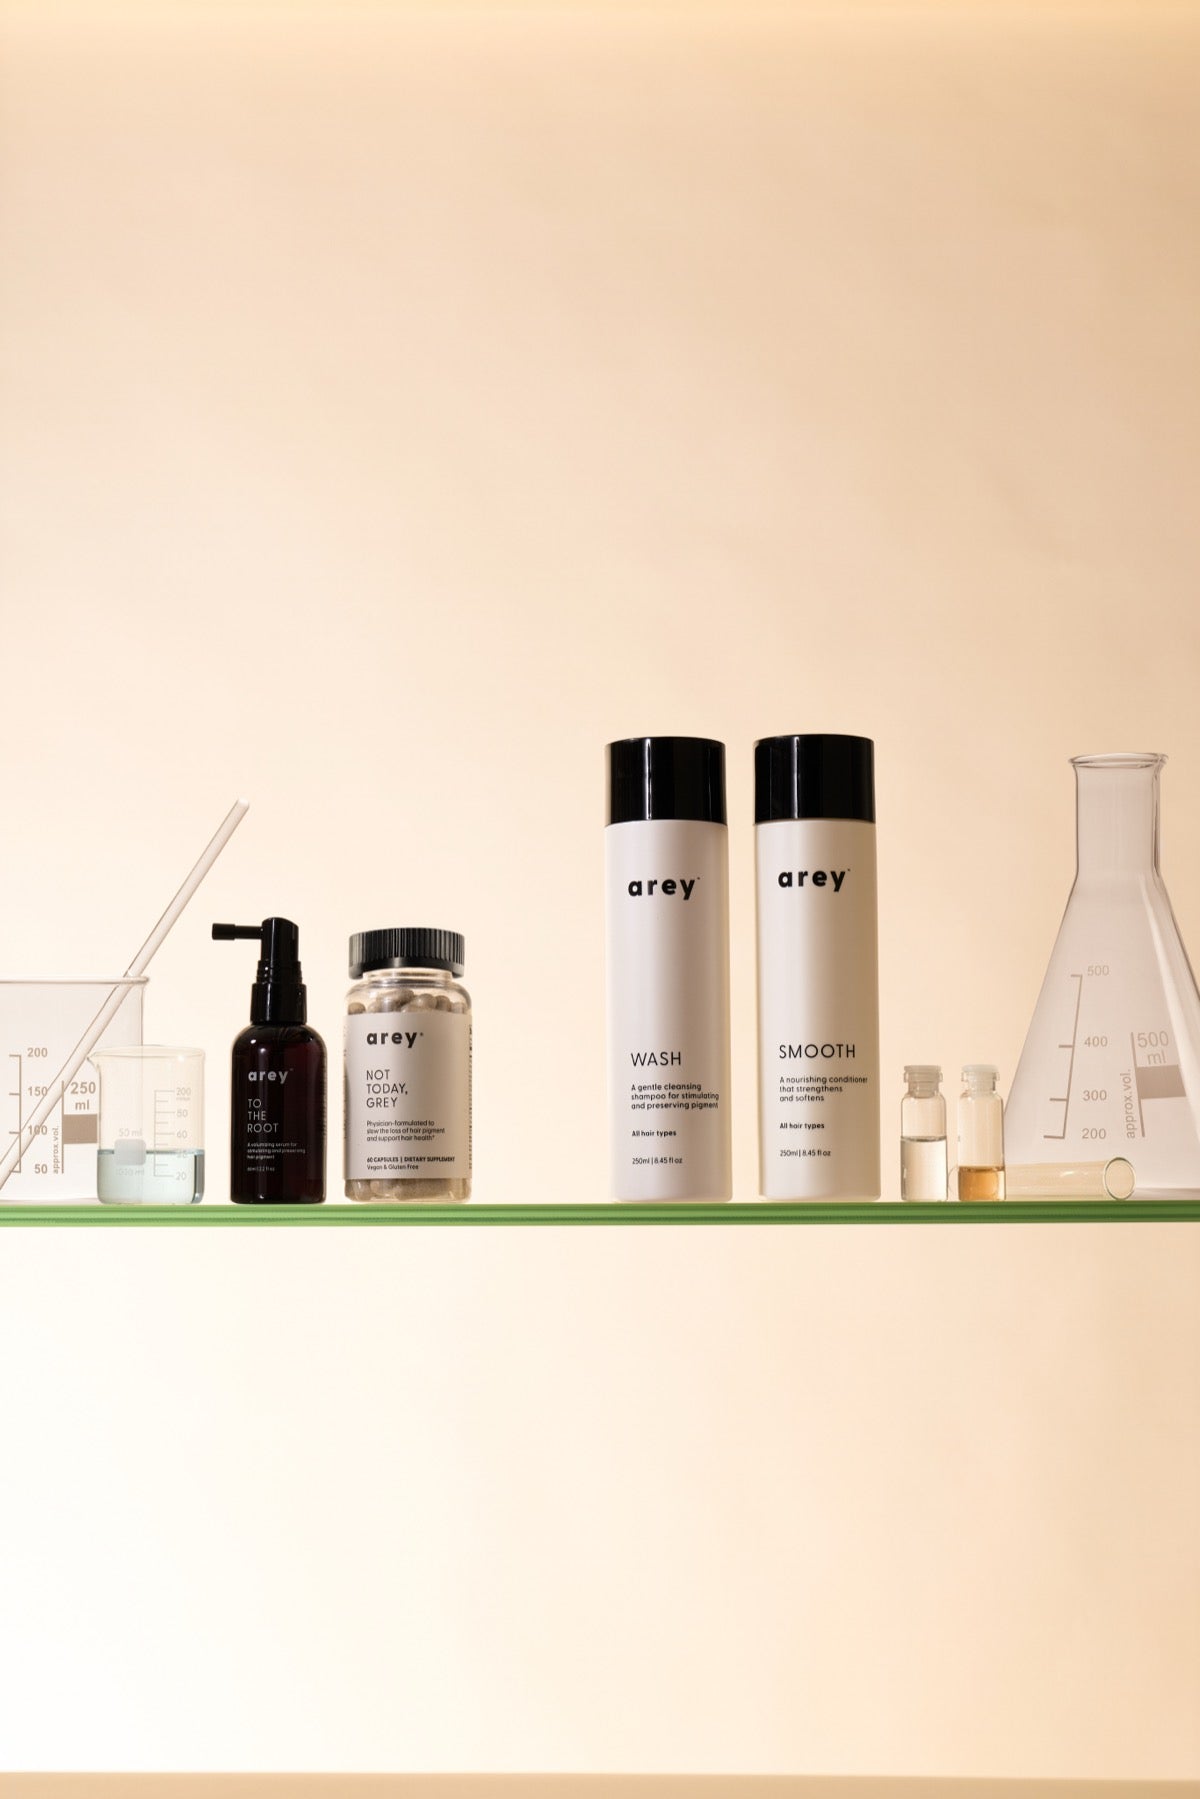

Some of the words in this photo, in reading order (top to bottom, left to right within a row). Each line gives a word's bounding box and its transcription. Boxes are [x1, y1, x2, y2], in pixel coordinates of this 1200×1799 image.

[778, 870, 846, 892] arey
[628, 878, 695, 900] arey
[1087, 965, 1110, 977] 500
[366, 1032, 417, 1049] arey
[1084, 1036, 1108, 1048] 400
[1137, 1030, 1169, 1048] 500
[27, 1047, 48, 1058] 200
[779, 1044, 855, 1059] SMOOTH
[631, 1051, 681, 1067] WASH
[1147, 1051, 1166, 1065] ml
[248, 1070, 288, 1084] arey
[366, 1069, 390, 1081] NOT
[786, 1075, 827, 1085] nourishing
[829, 1075, 868, 1083] conditioner
[28, 1086, 48, 1097] 150
[70, 1081, 96, 1094] 250
[366, 1083, 408, 1095] TODAY,
[637, 1084, 662, 1092] gentle
[664, 1083, 702, 1092] cleansing
[796, 1085, 843, 1094] strengthens
[631, 1093, 666, 1102] shampoo
[681, 1092, 719, 1101] stimulating
[795, 1094, 824, 1102] softens
[1083, 1090, 1107, 1101] 300
[75, 1099, 90, 1110] ml
[247, 1099, 262, 1108] TO
[366, 1097, 398, 1108] GREY
[631, 1102, 645, 1110] and
[647, 1101, 689, 1110] preserving
[691, 1101, 718, 1110] pigment
[1120, 1068, 1136, 1139] approx.vol.
[247, 1111, 267, 1121] THE
[28, 1125, 48, 1135] 100
[247, 1123, 279, 1133] ROOT
[421, 1127, 445, 1135] pigment
[1082, 1128, 1107, 1139] 200
[657, 1130, 677, 1138] types
[52, 1125, 61, 1174] approx.vol.
[34, 1164, 48, 1174] 50
